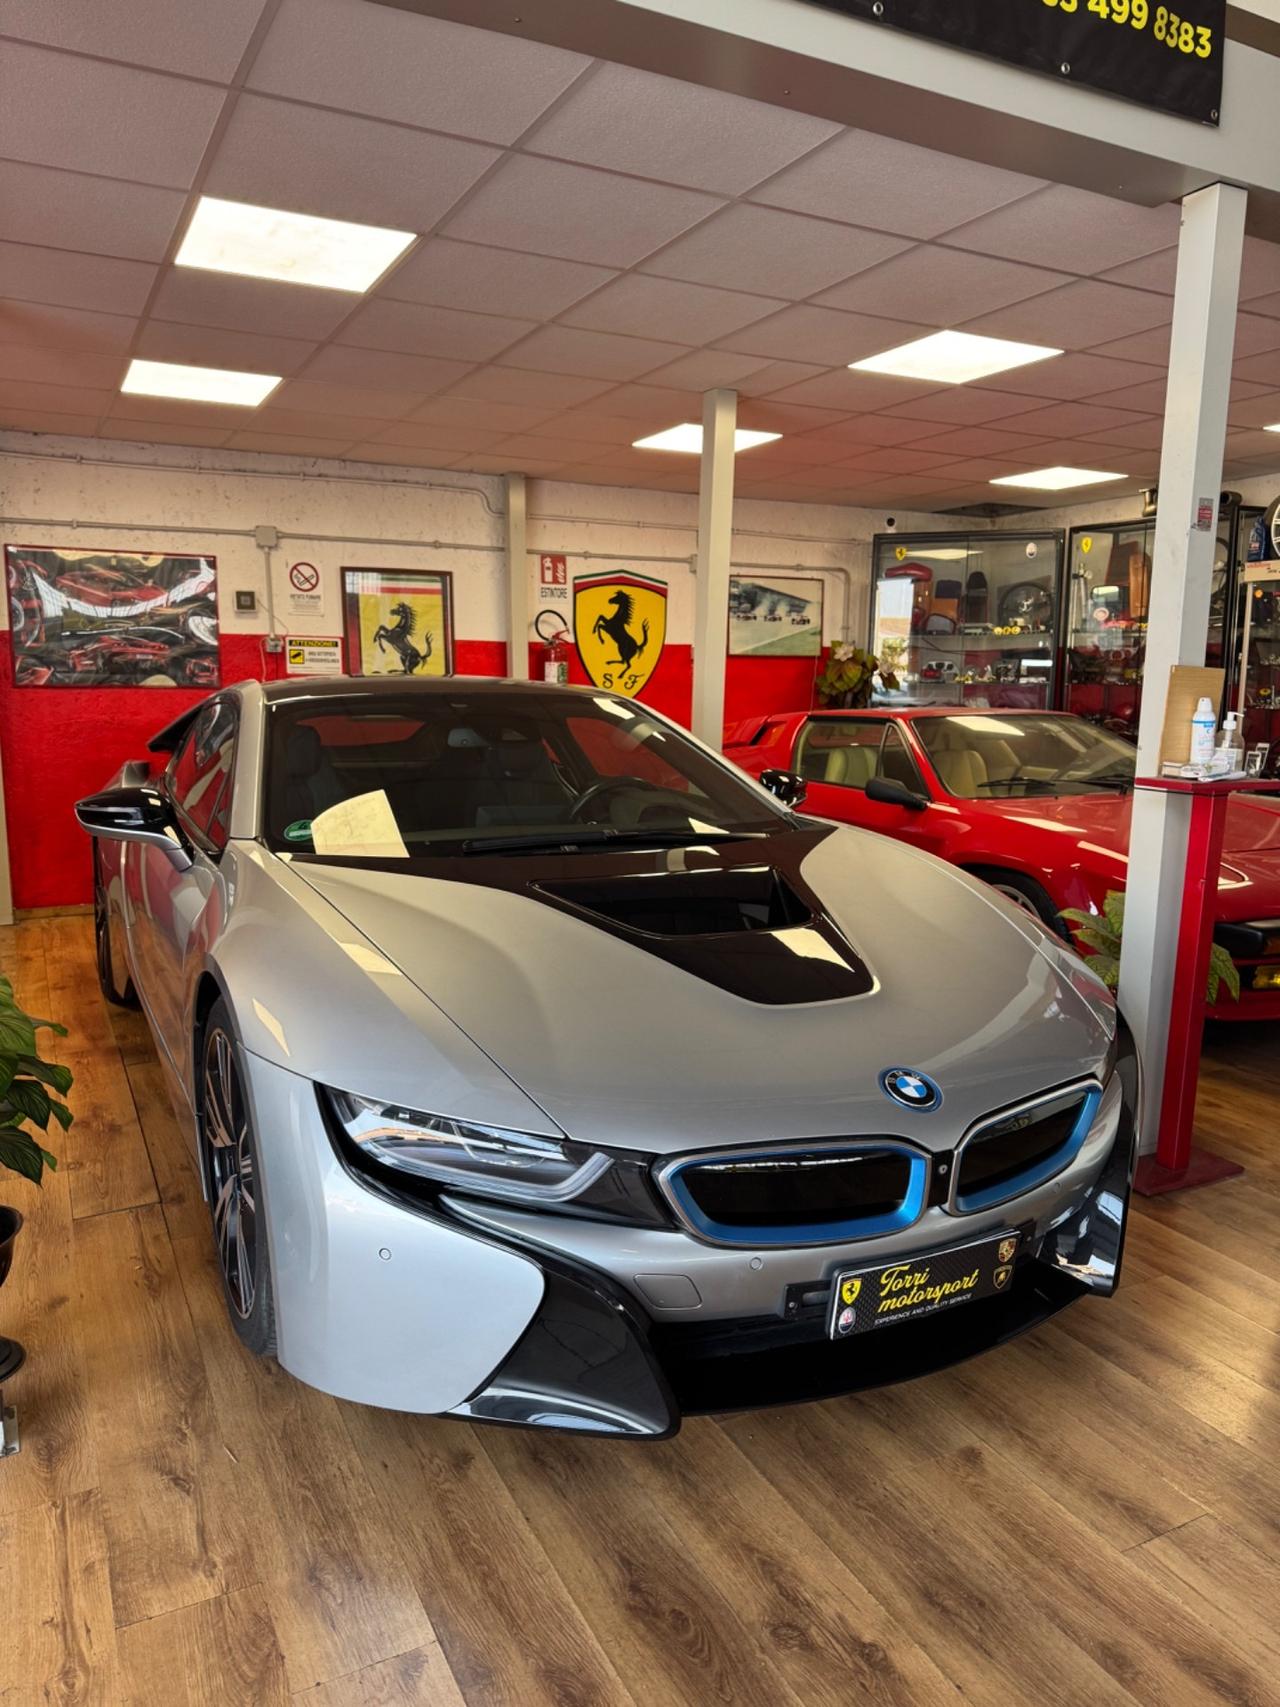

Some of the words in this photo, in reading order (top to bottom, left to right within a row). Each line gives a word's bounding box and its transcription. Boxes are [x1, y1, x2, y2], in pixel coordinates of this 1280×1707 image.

[1087, 0, 1149, 30] 499
[1153, 6, 1212, 58] 8383
[602, 673, 614, 689] S
[877, 1268, 980, 1313] motorsport
[879, 1264, 930, 1297] Torri
